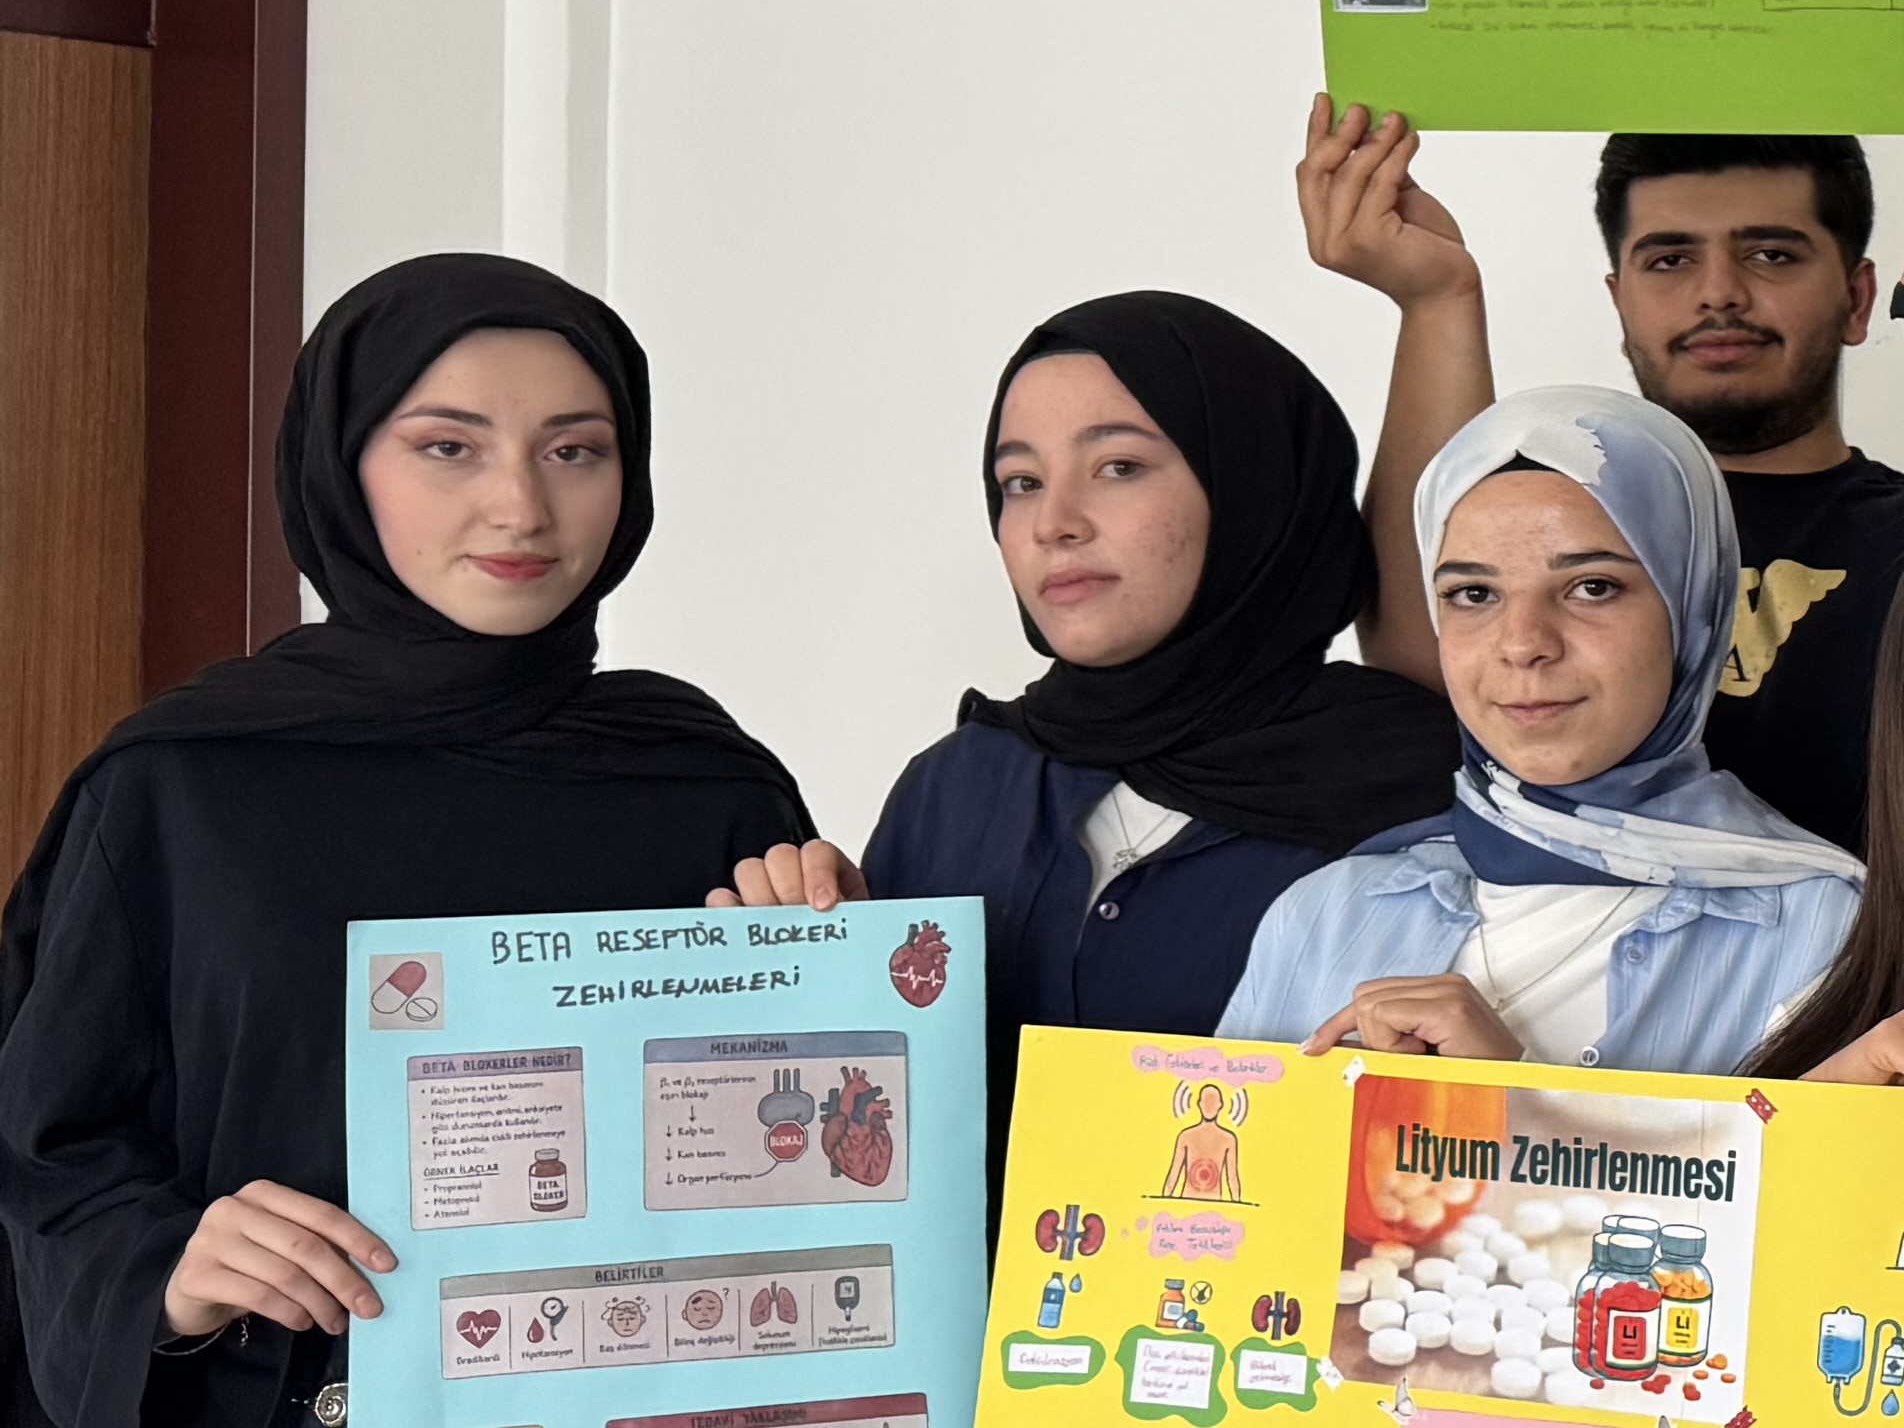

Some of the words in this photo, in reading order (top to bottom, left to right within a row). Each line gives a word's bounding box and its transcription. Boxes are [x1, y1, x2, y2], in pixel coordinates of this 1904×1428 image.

[492, 931, 571, 964] BETA
[597, 922, 727, 953] RESEPTÖR
[748, 918, 847, 946] BLOKERİ
[711, 1039, 788, 1054] MEKANİZMA
[1396, 1123, 1500, 1183] Lityum
[1511, 1135, 1737, 1202] Zehirlenmesi
